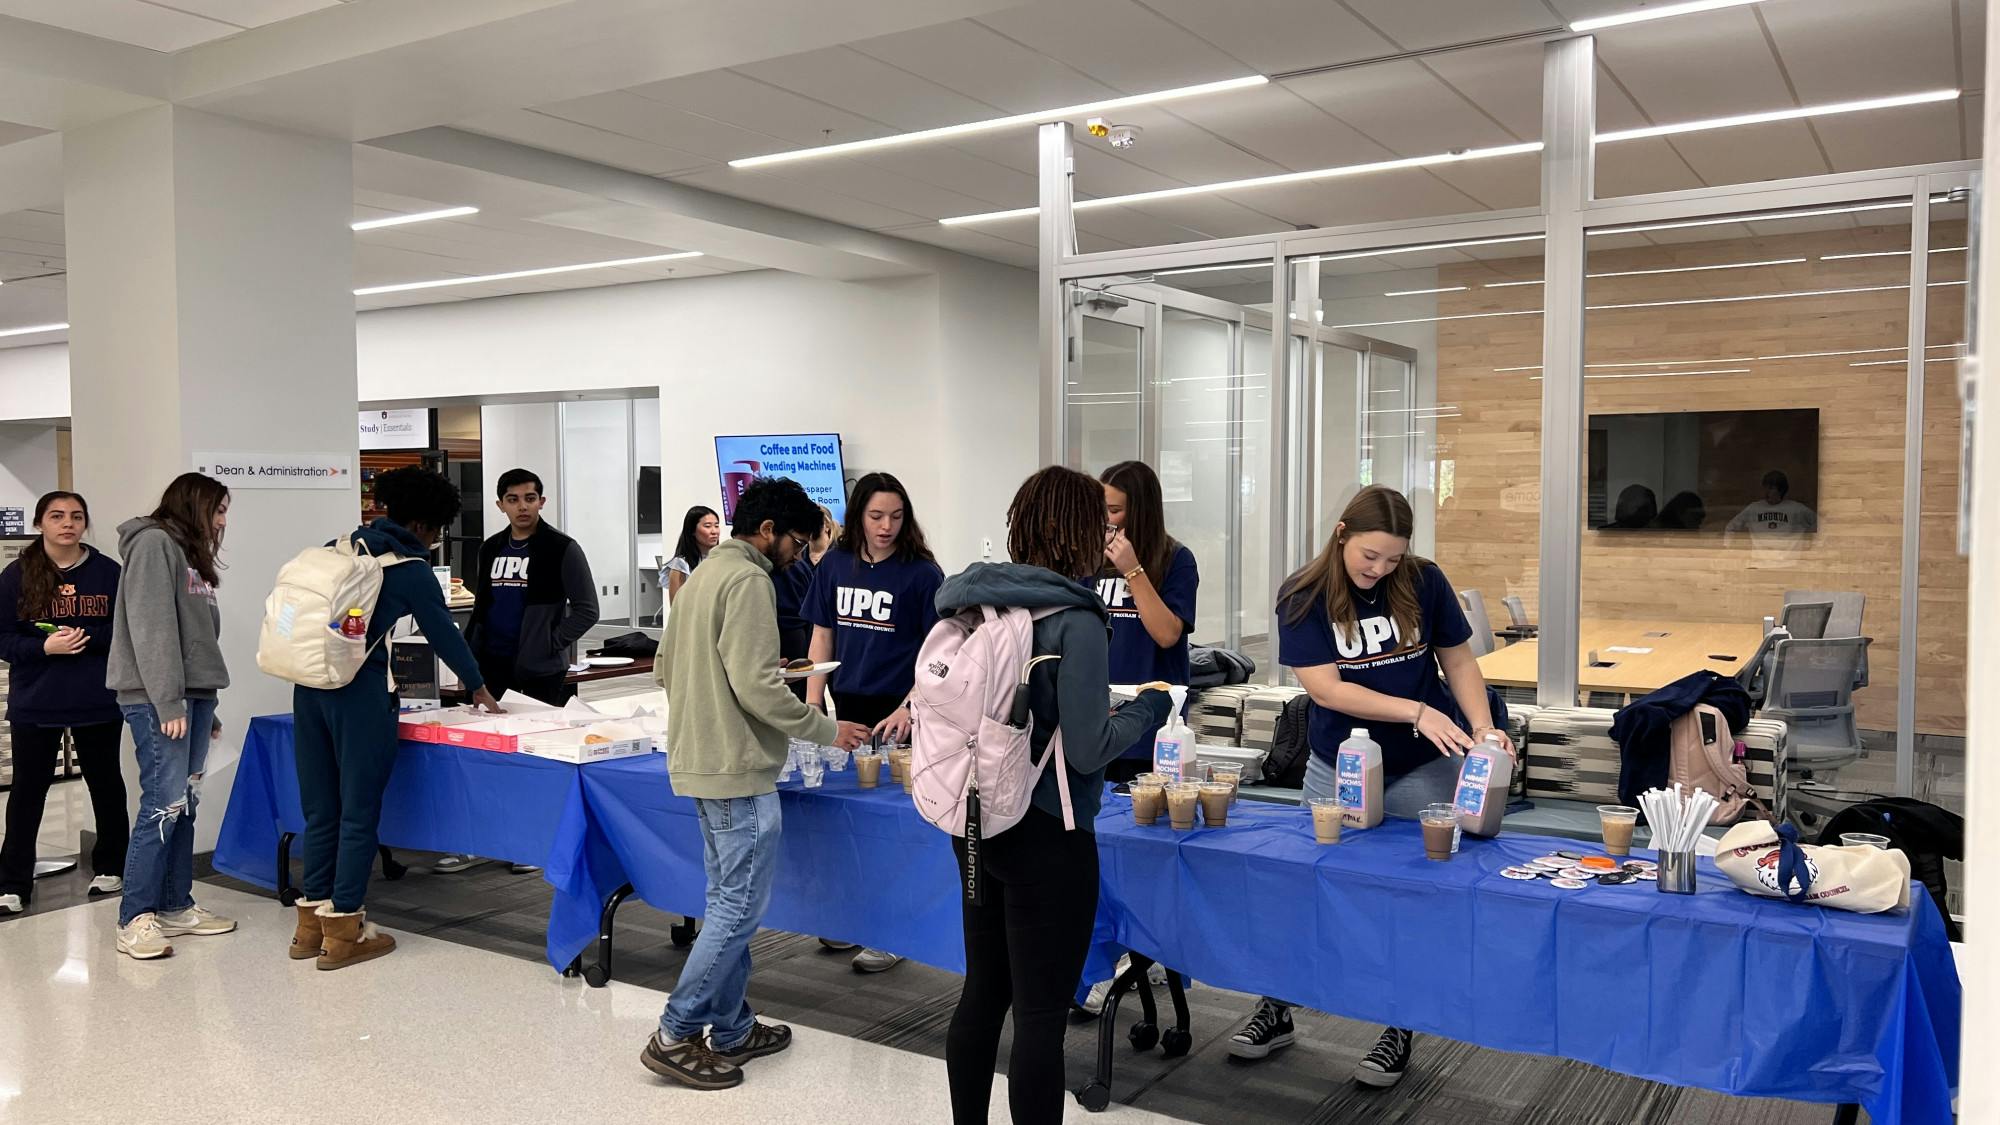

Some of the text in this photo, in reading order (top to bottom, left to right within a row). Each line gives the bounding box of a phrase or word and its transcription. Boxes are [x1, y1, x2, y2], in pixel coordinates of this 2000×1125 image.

[360, 423, 379, 435] Study
[760, 442, 834, 456] Coffee and Food
[215, 465, 328, 477] Dean & Administration
[763, 460, 837, 474] Vending Machines
[836, 586, 894, 621] UPC
[1338, 662, 1370, 670] IVERSITY
[1371, 655, 1406, 668] PROGRAM
[967, 822, 977, 899] lululemon
[1820, 885, 1850, 899] COUNCIL
